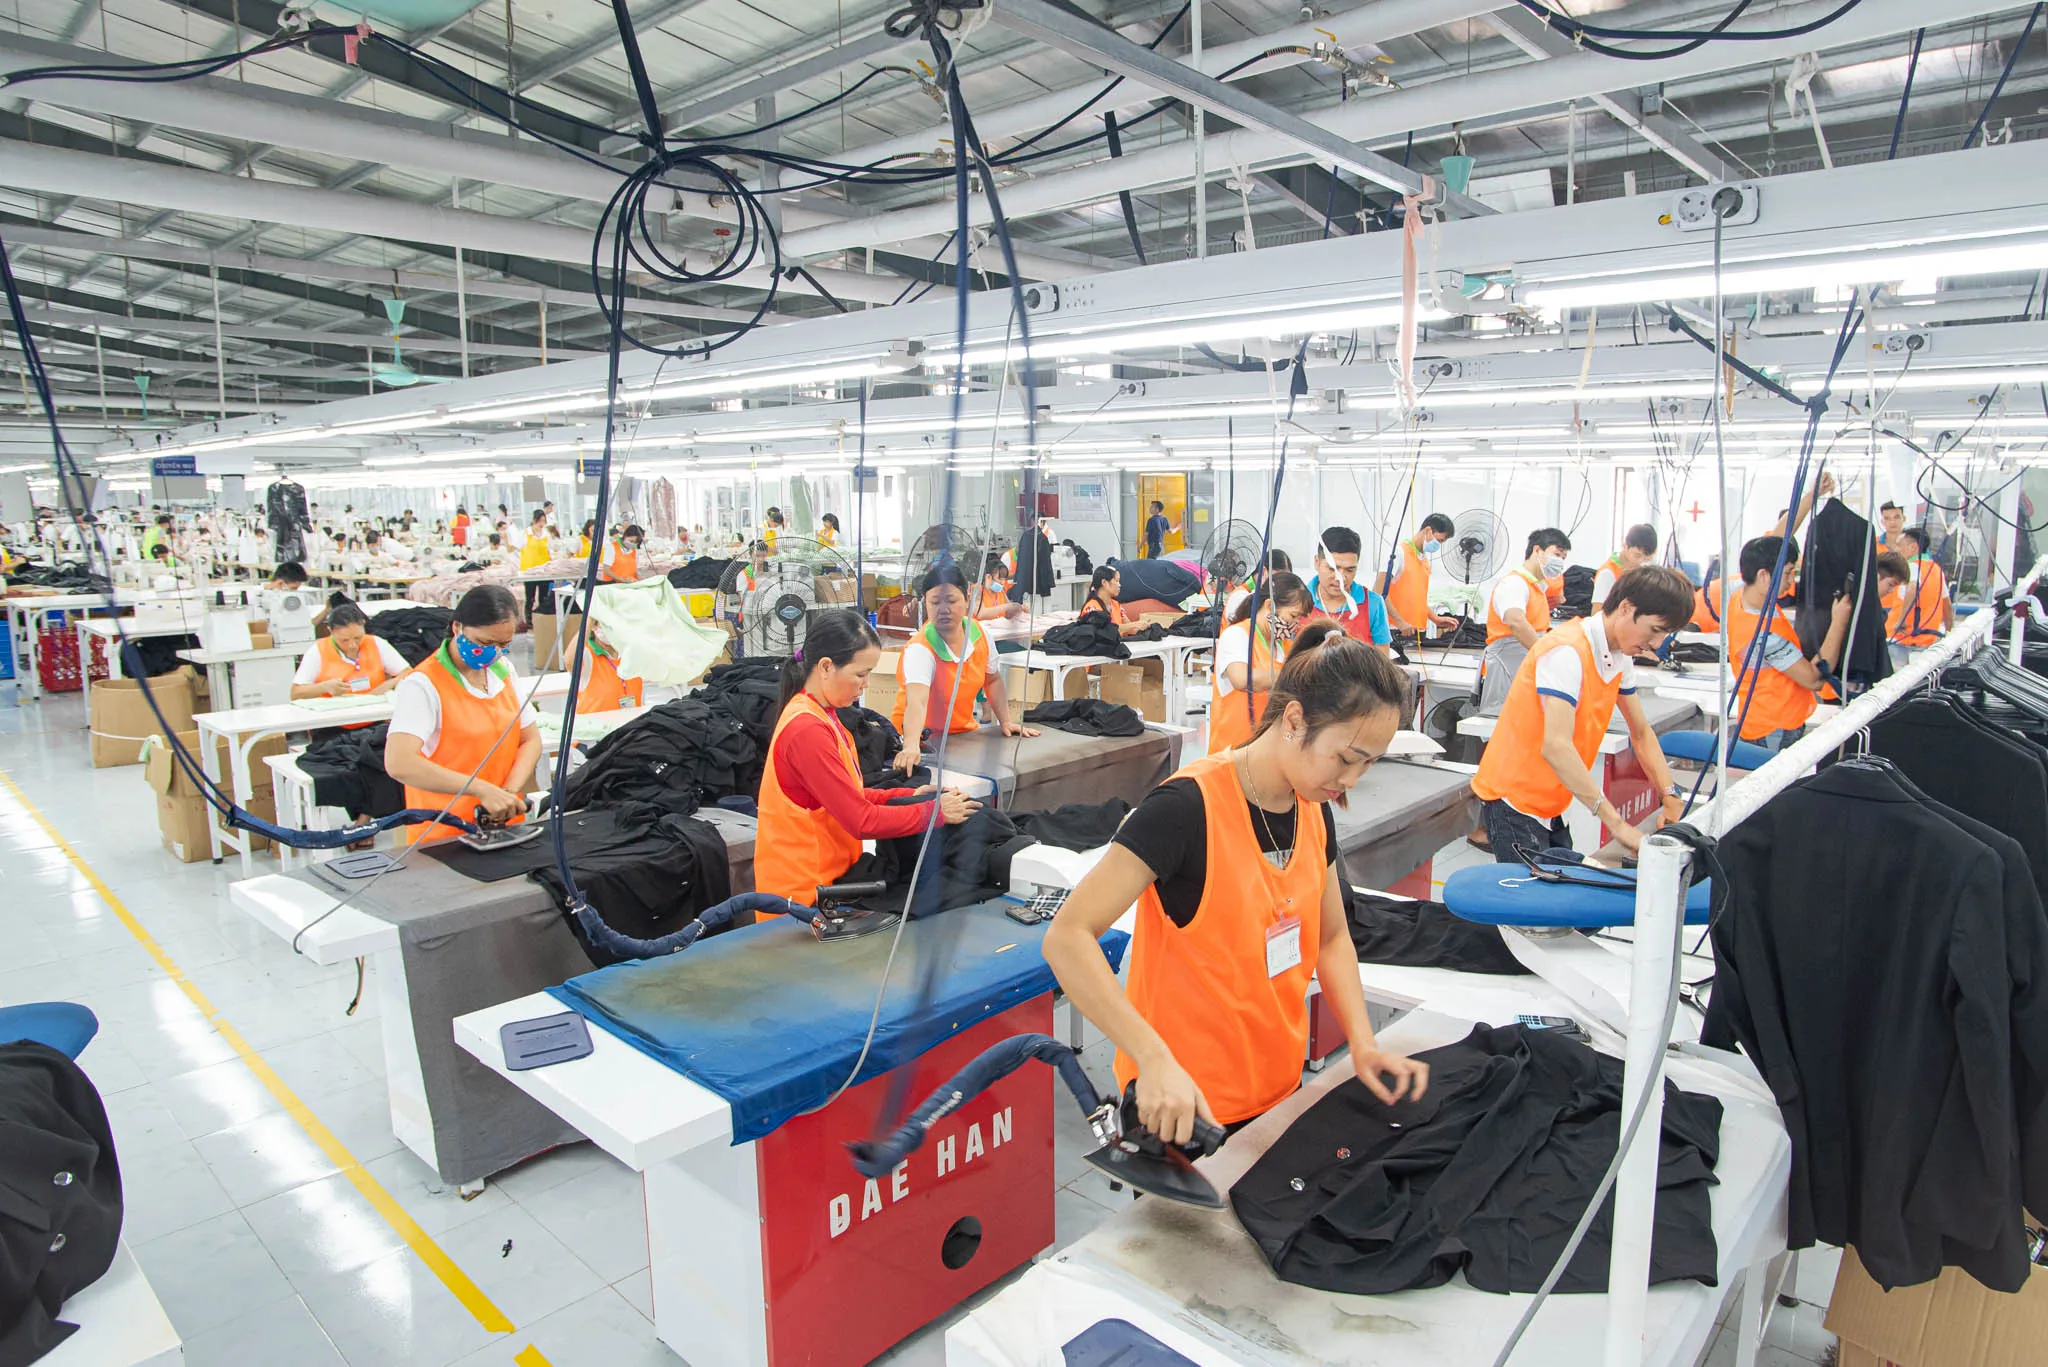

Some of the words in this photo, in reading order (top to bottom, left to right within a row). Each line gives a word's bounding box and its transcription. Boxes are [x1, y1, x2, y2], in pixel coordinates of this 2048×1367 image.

[1616, 800, 1632, 821] AE
[1634, 788, 1651, 815] HAN
[829, 1158, 910, 1239] DAE
[936, 1106, 1012, 1178] HAN
